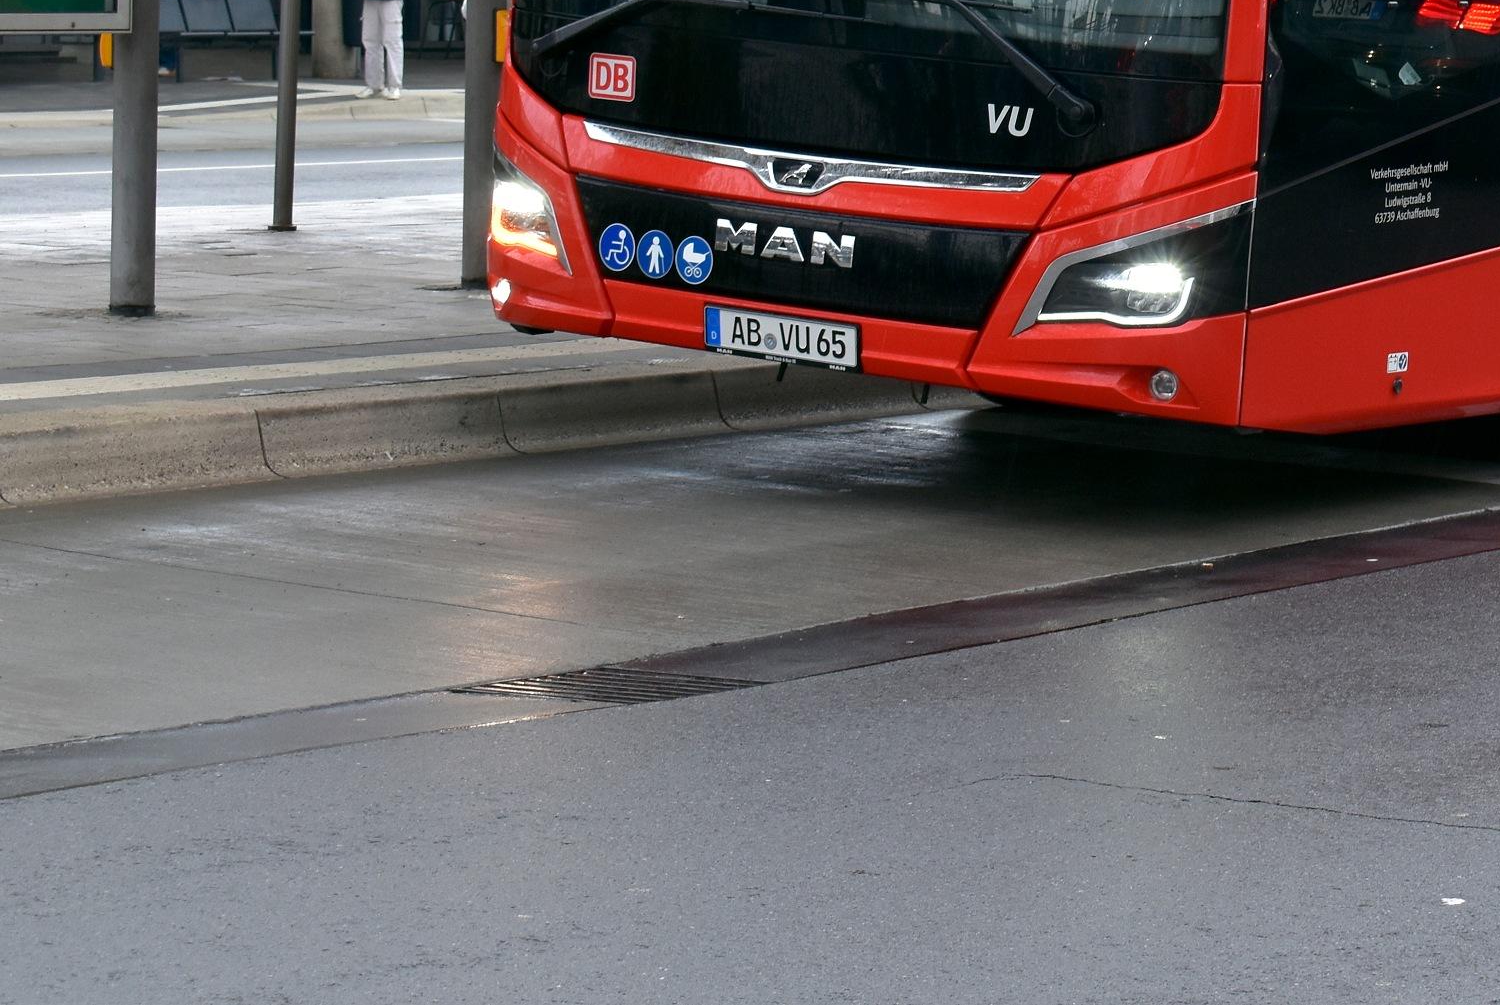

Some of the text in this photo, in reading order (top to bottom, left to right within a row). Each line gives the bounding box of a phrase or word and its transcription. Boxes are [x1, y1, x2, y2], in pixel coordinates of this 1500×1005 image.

[594, 59, 631, 94] DB
[987, 103, 1034, 137] VU
[1370, 160, 1449, 179] Verkehrsgesellschaft mbH
[1385, 177, 1432, 193] Untermain -VU-
[1385, 192, 1432, 208] Ludwigstraße 8
[1374, 207, 1440, 224] 63739 Aschaffenburg
[715, 218, 856, 269] MAN
[711, 316, 846, 359] D AB VU 65
